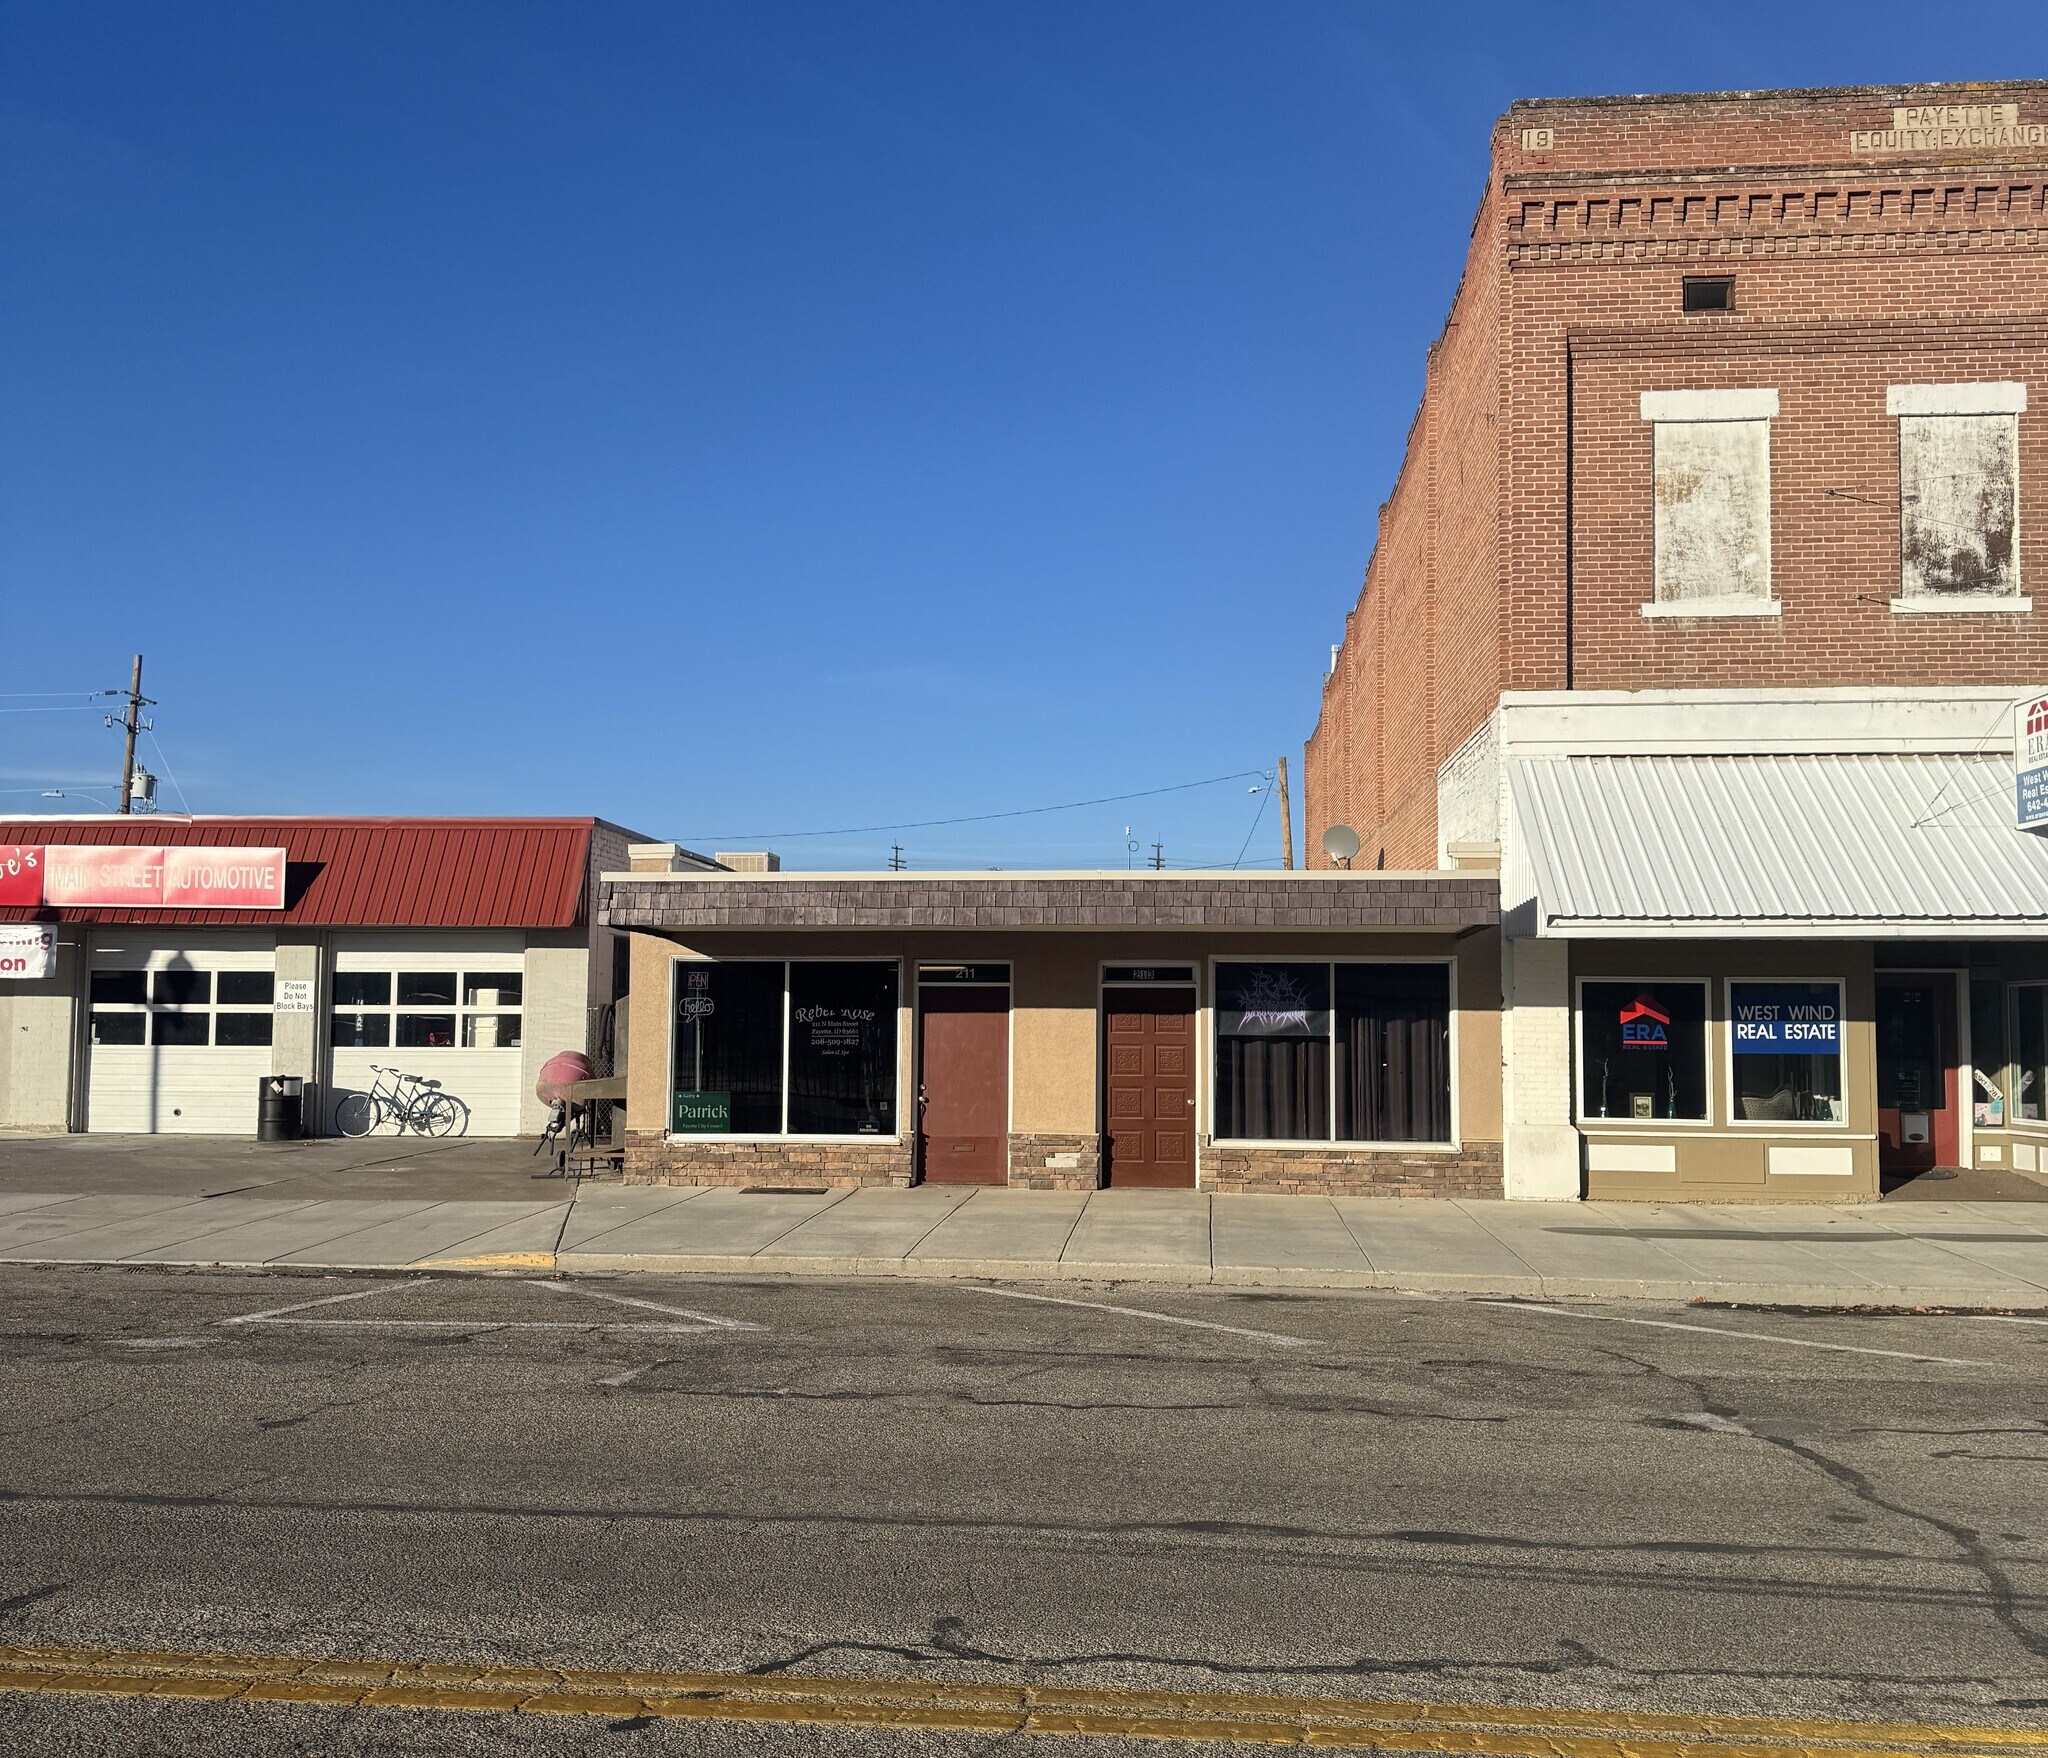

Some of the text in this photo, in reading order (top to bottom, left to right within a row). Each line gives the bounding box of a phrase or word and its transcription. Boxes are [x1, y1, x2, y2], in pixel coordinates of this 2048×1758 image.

[1906, 105, 2003, 126] PAYETTE
[1527, 131, 1548, 148] 19
[2023, 773, 2041, 786] West
[2022, 786, 2039, 800] Real
[0, 847, 38, 879] e's
[52, 864, 275, 890] MAIN STREET AUTOMOTIVE
[687, 973, 707, 987] PEN
[955, 968, 975, 979] 211
[1134, 970, 1154, 980] 213
[284, 982, 307, 990] Please
[284, 992, 307, 1000] Do Not
[276, 1002, 314, 1011] Block Bays
[684, 999, 711, 1014] hello
[1737, 1005, 1835, 1020] WEST WIND
[1622, 1023, 1667, 1040] ERA
[1737, 1023, 1835, 1039] REAL ESTATE
[811, 1038, 859, 1046] 208-509-1827
[679, 1104, 728, 1118] Patrick
